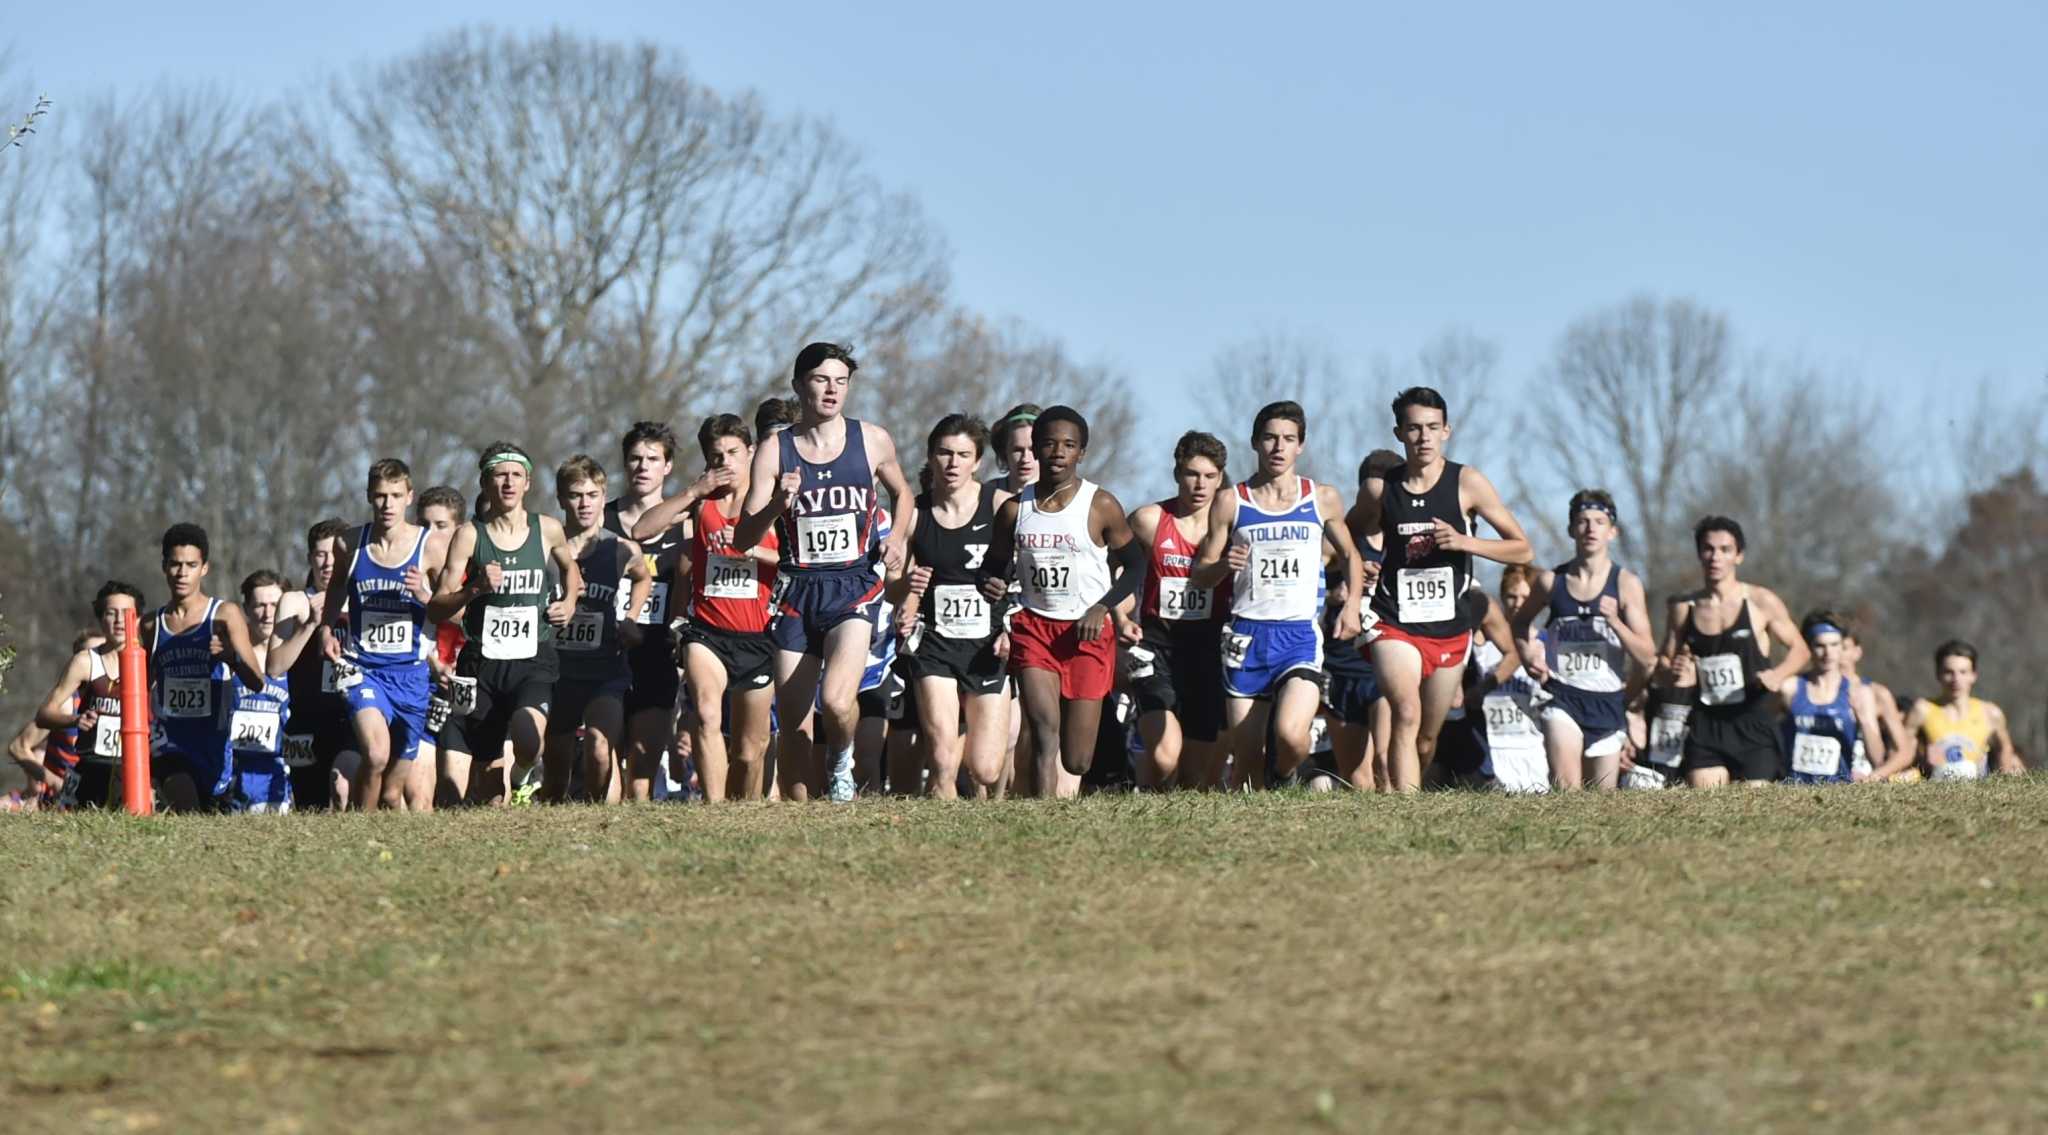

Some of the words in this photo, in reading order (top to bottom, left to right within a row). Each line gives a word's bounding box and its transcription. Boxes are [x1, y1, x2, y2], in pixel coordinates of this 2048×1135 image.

[791, 486, 868, 515] AVON
[806, 529, 849, 552] 1973
[1248, 526, 1310, 542] TOLLAND
[712, 566, 751, 587] 2002
[1031, 565, 1070, 588] 2037
[1260, 558, 1299, 579] 2144
[499, 569, 544, 595] FIELD
[588, 582, 616, 602] OTT
[1406, 580, 1446, 600] 1995
[623, 592, 661, 614] 256
[943, 598, 982, 617] 2171
[1168, 590, 1206, 610] 2105
[368, 623, 406, 643] 2019
[491, 619, 530, 638] 2034
[555, 624, 596, 642] 2166
[1565, 653, 1601, 671] 2070
[168, 689, 205, 709] 2023
[239, 723, 271, 743] 2024
